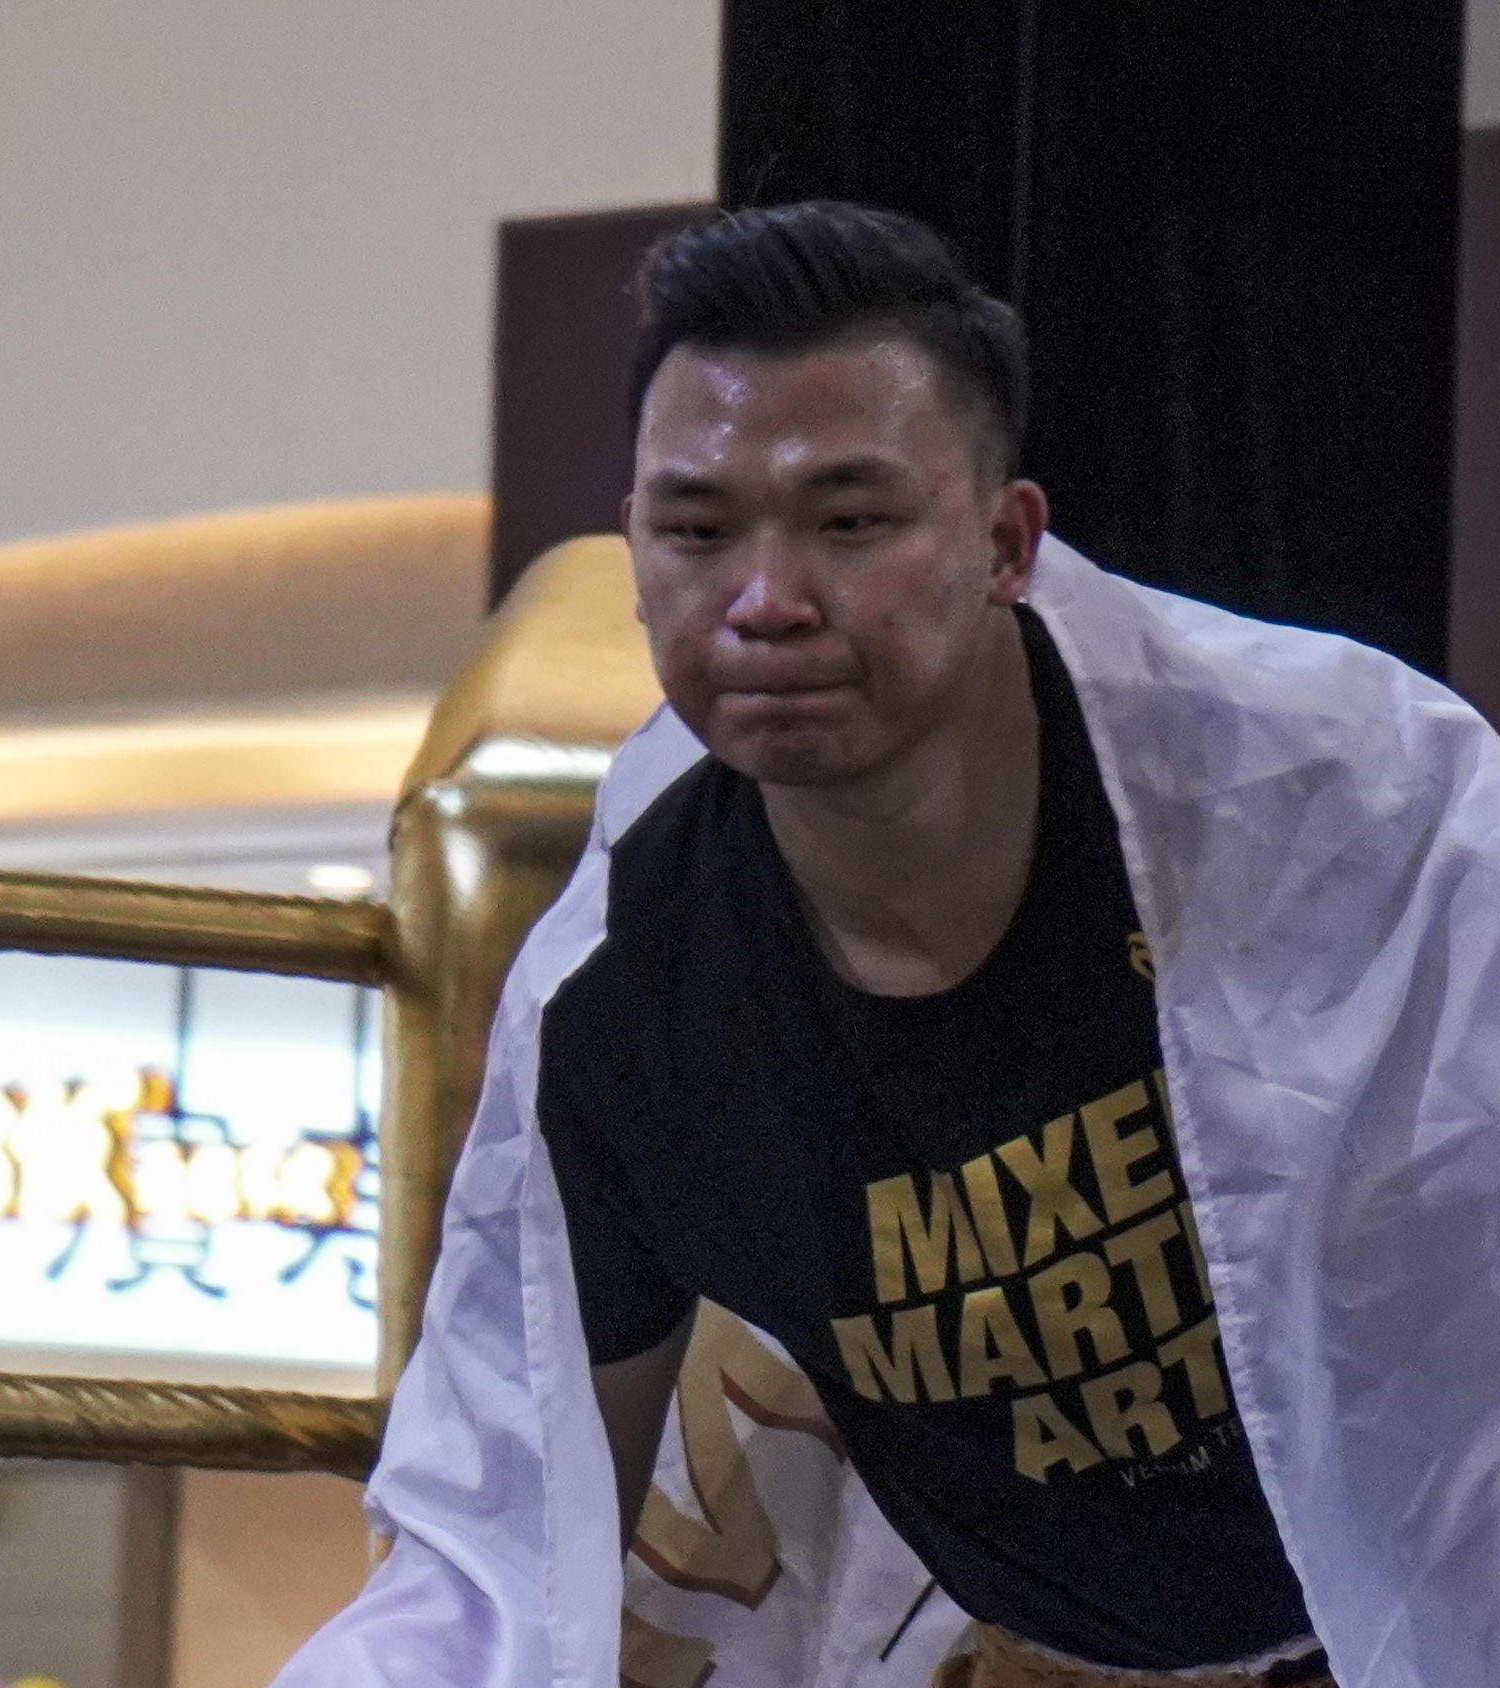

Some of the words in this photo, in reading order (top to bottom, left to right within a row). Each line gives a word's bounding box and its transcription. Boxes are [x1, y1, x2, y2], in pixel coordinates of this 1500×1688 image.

[865, 1068, 1178, 1304] MIXE
[830, 1200, 1213, 1405] MART
[1012, 1322, 1230, 1486] ART
